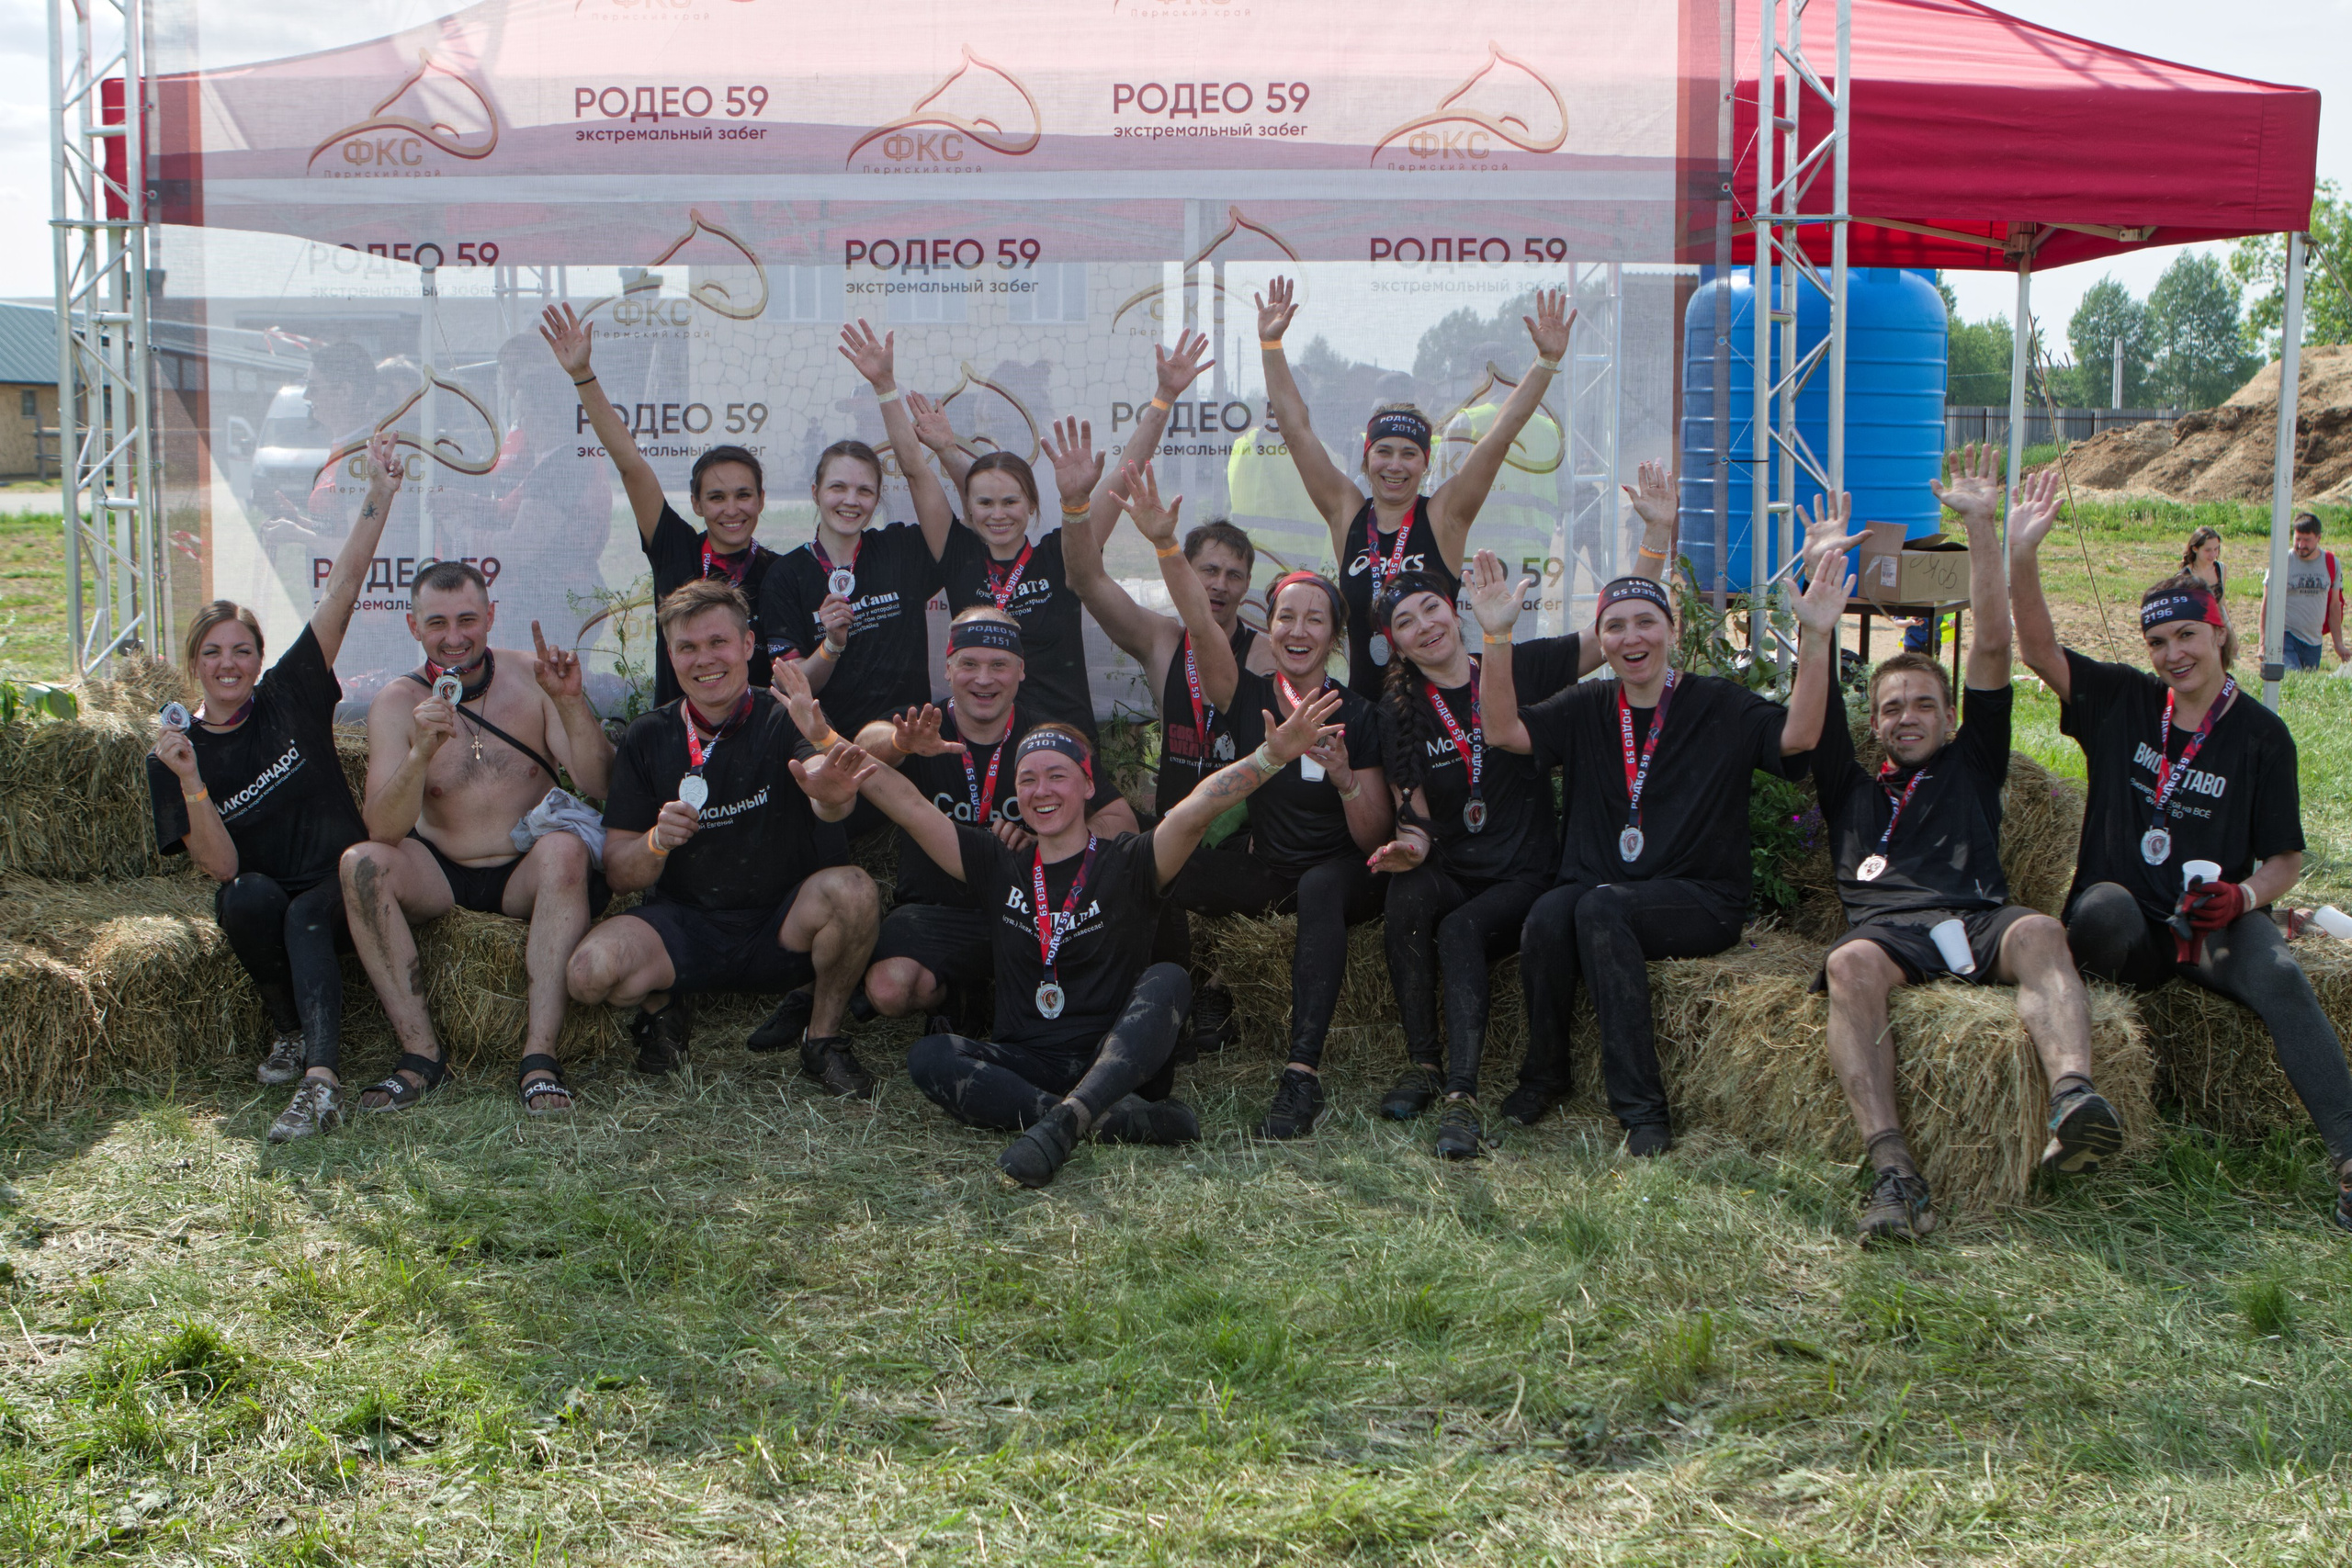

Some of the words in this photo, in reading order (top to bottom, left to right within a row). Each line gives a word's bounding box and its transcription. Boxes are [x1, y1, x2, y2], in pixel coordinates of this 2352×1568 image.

[575, 86, 712, 122] РОДЕО
[726, 85, 769, 118] 59
[1114, 82, 1253, 118] РОДЕО
[1266, 82, 1310, 114] 59
[575, 126, 713, 143] экстремальный
[718, 127, 768, 141] забег
[1114, 122, 1253, 141] экстремальный
[1257, 122, 1308, 138] забег
[343, 138, 423, 167] ФКС
[882, 133, 964, 163] ФКС
[1408, 130, 1490, 160] ФКС
[323, 168, 401, 179] Пермский
[404, 168, 442, 179] край
[863, 164, 942, 175] Пермский
[946, 164, 982, 175] край
[1388, 161, 1468, 172] Пермский
[1472, 161, 1510, 172] край
[309, 243, 444, 279] РОДЕО
[458, 243, 499, 274] 59
[845, 239, 984, 275] РОДЕО
[997, 238, 1041, 270] 59
[1370, 237, 1510, 273] РОДЕО
[1523, 237, 1567, 269] 59
[845, 278, 983, 296] экстремальный
[989, 278, 1038, 294] забег
[1370, 278, 1510, 295] экстремальный
[1516, 277, 1566, 293] забег
[613, 298, 694, 327] ФКС
[674, 328, 711, 339] край
[725, 402, 768, 434] 59
[1379, 415, 1416, 424] РОДЕО
[1391, 423, 1417, 436] 2014
[577, 444, 711, 457] эксмальный
[348, 453, 426, 481] ФС
[1393, 525, 1409, 560] РОДЕО
[1372, 566, 1380, 578] 59
[1389, 562, 1398, 574] 59
[1521, 557, 1565, 589] 59
[1005, 563, 1024, 592] РОДЕО
[1612, 588, 1628, 597] 59
[2173, 595, 2188, 604] 59
[1522, 597, 1563, 611] абег
[2144, 608, 2173, 624] 2196
[967, 626, 1007, 636] РОДЕО
[982, 635, 1011, 647] 2151
[1186, 649, 1198, 684] РОДЕО
[1192, 686, 1201, 699] 59
[1431, 694, 1456, 727] РОДЕО
[1452, 728, 1464, 742] 59
[1473, 728, 1482, 741] 59
[1622, 708, 1634, 748] РОДЕО
[1027, 739, 1057, 750] 2101
[1058, 734, 1072, 743] 59
[1472, 744, 1483, 784] РОДЕО
[1625, 750, 1635, 764] 59
[966, 767, 976, 781] 59
[989, 763, 998, 777] 59
[1630, 771, 1647, 809] РОДЕО
[1640, 754, 1651, 768] 59
[2155, 773, 2182, 810] РОДЕО
[2177, 757, 2190, 771] 59
[1034, 865, 1046, 902] РОДЕО
[1038, 903, 1048, 917] 59
[1046, 927, 1064, 965] РОДЕО
[1059, 910, 1071, 925] 59
